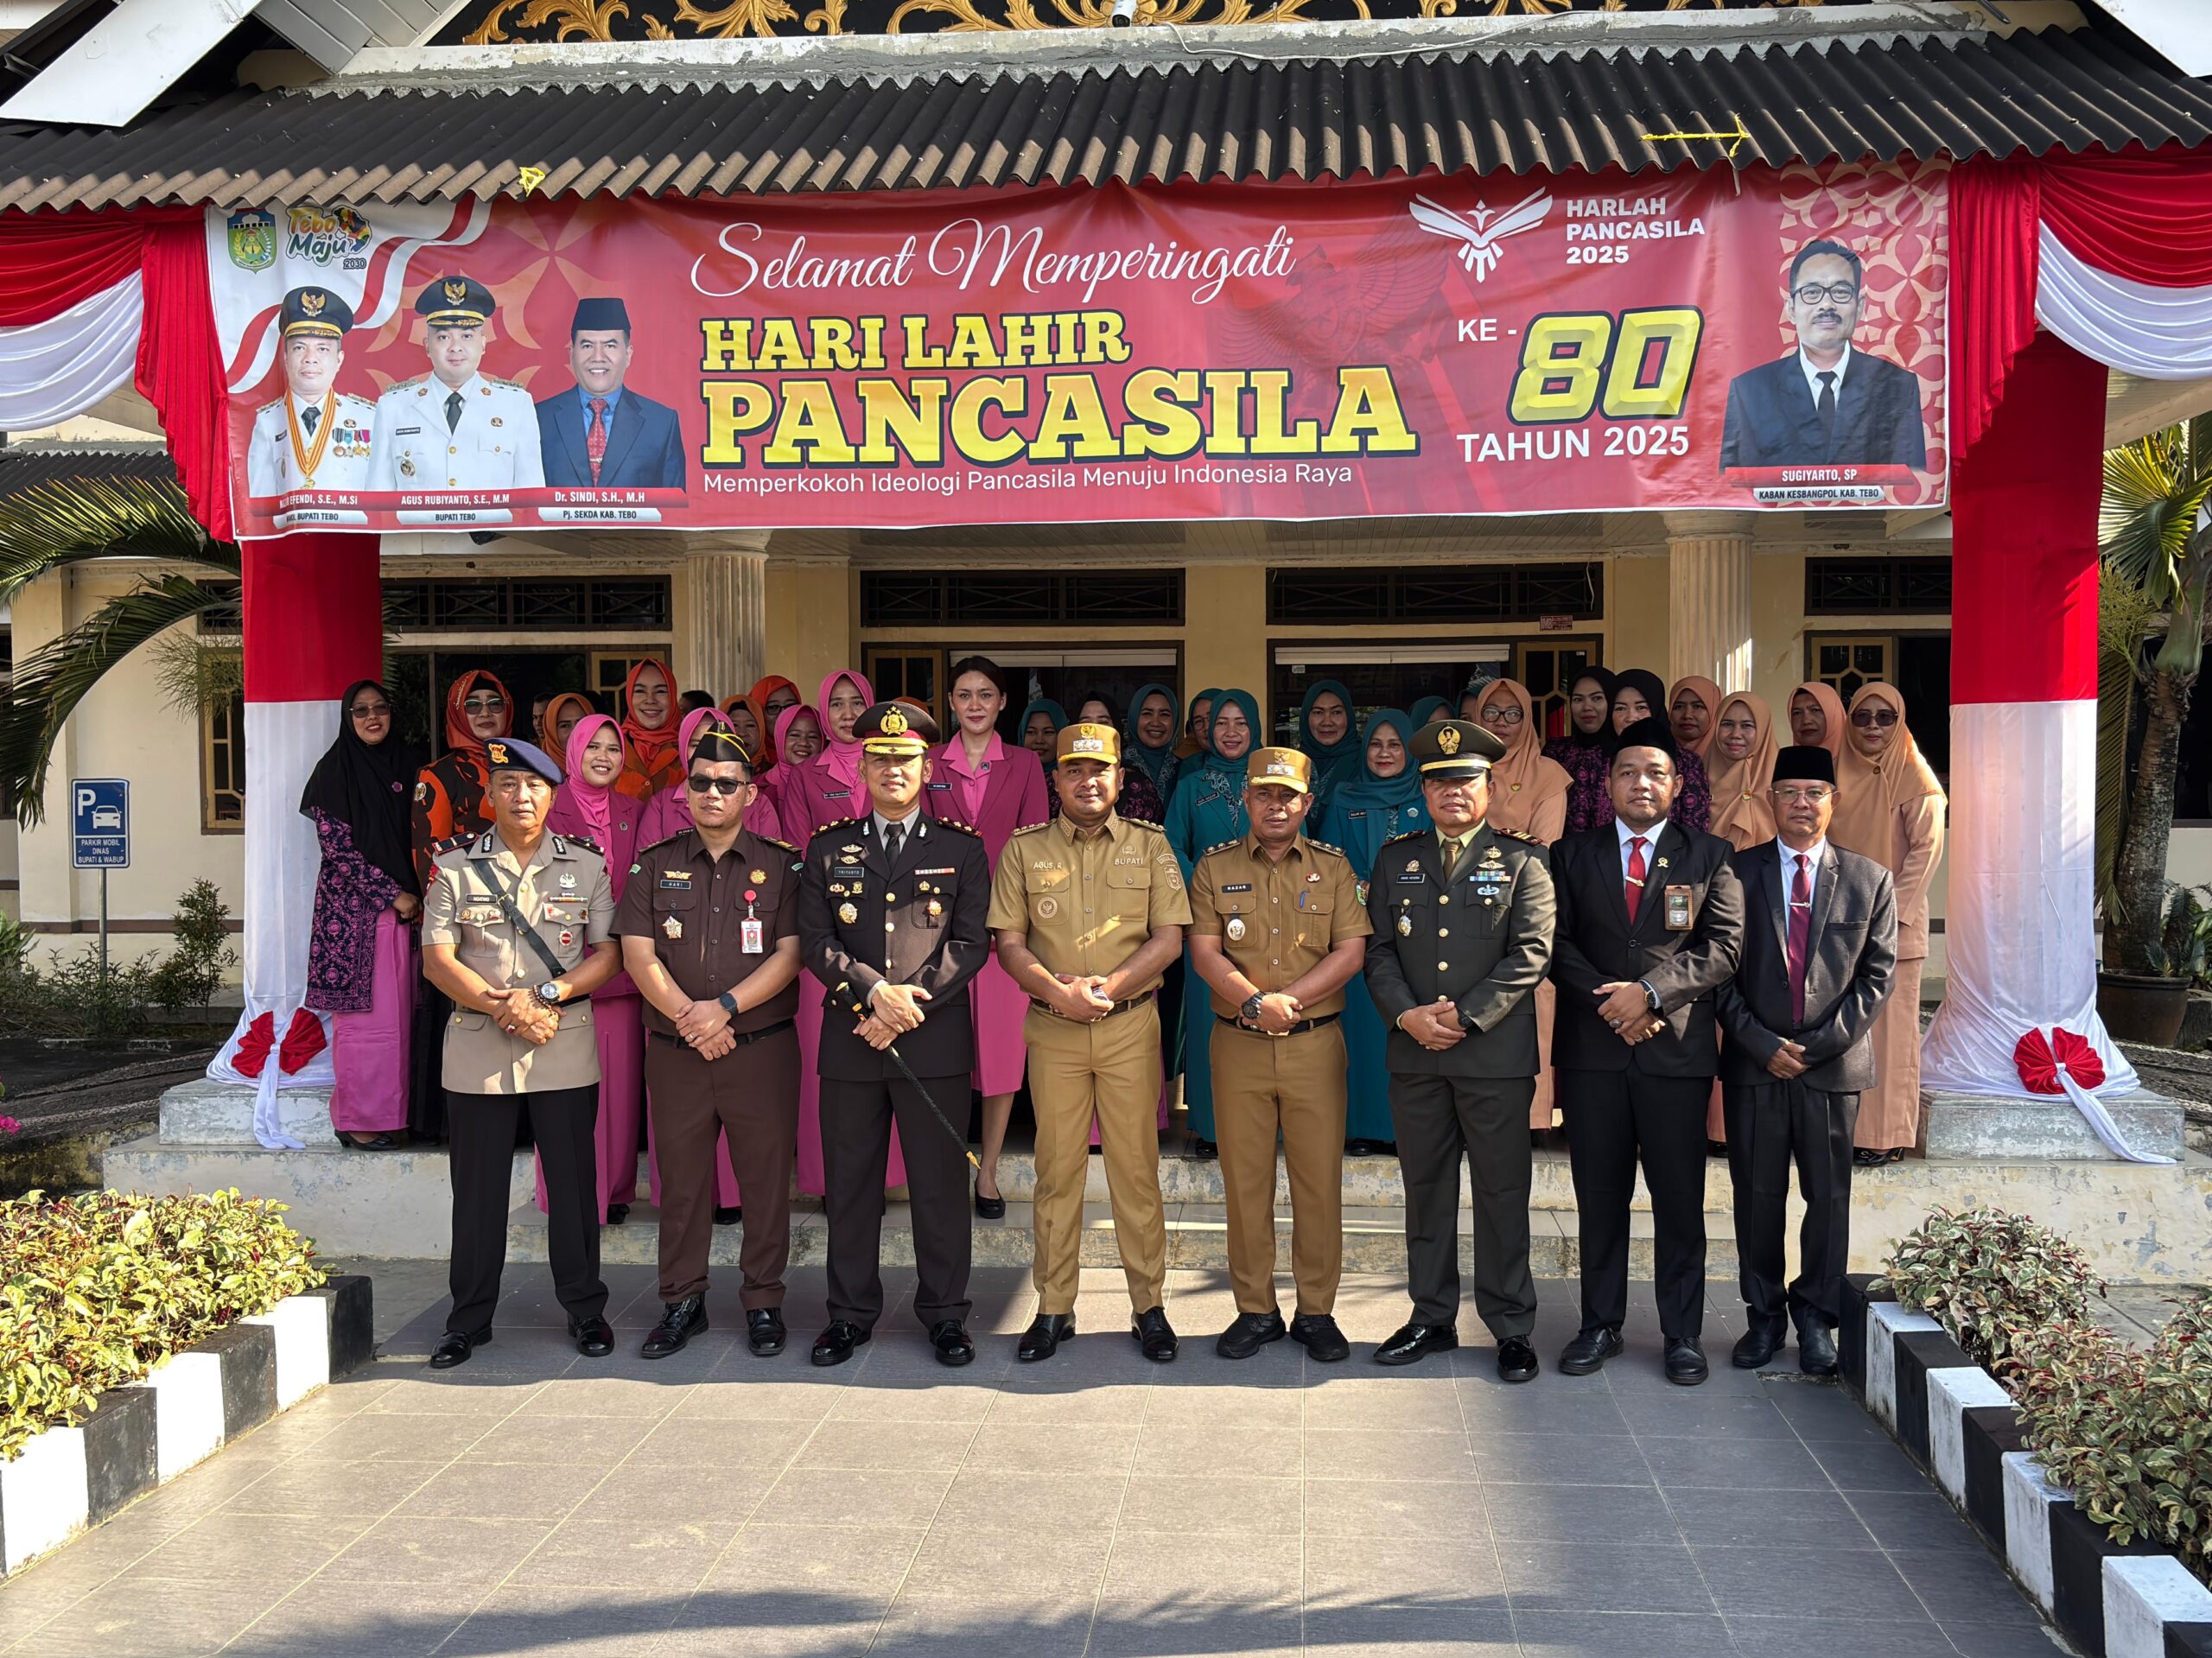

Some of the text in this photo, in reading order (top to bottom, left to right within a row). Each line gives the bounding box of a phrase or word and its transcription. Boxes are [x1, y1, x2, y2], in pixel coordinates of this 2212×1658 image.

[1567, 197, 1667, 218] HARLAH
[289, 206, 337, 234] Tebo
[1566, 218, 1705, 241] PANCASILA
[289, 233, 347, 263] Maju
[1566, 245, 1630, 264] 2025
[343, 258, 366, 269] 2030
[690, 218, 1297, 305] Selamat Memperingati
[699, 308, 1132, 372] HARI LAHIR
[1457, 318, 1497, 343] KE
[1507, 304, 1704, 426] 80
[702, 364, 1421, 468] PANCASILA
[1457, 426, 1689, 463] TAHUN 2025
[704, 464, 1352, 497] Memperkokoh Ideologi Pancasila Menuju Indonesia Raya
[1782, 469, 1857, 482] SUGIYARTO, SP
[289, 494, 315, 505] EFENDI,
[317, 494, 337, 505] S.E.,
[339, 494, 358, 505] M.Si
[401, 493, 510, 506] AGUS RUBIYANTO, S.E., M.M
[555, 492, 645, 504] Dr. SINDI, S.H., M.H
[1758, 488, 1878, 499] KABAN KESBANGPOL KAB. TEBO
[297, 512, 319, 521] BUPATI
[321, 512, 339, 521] TEBO
[435, 513, 458, 522] BUPATI
[563, 511, 637, 520] Pj. SEKDA KAB. TEBO
[77, 788, 97, 816] P
[1115, 857, 1144, 866] BUPATI
